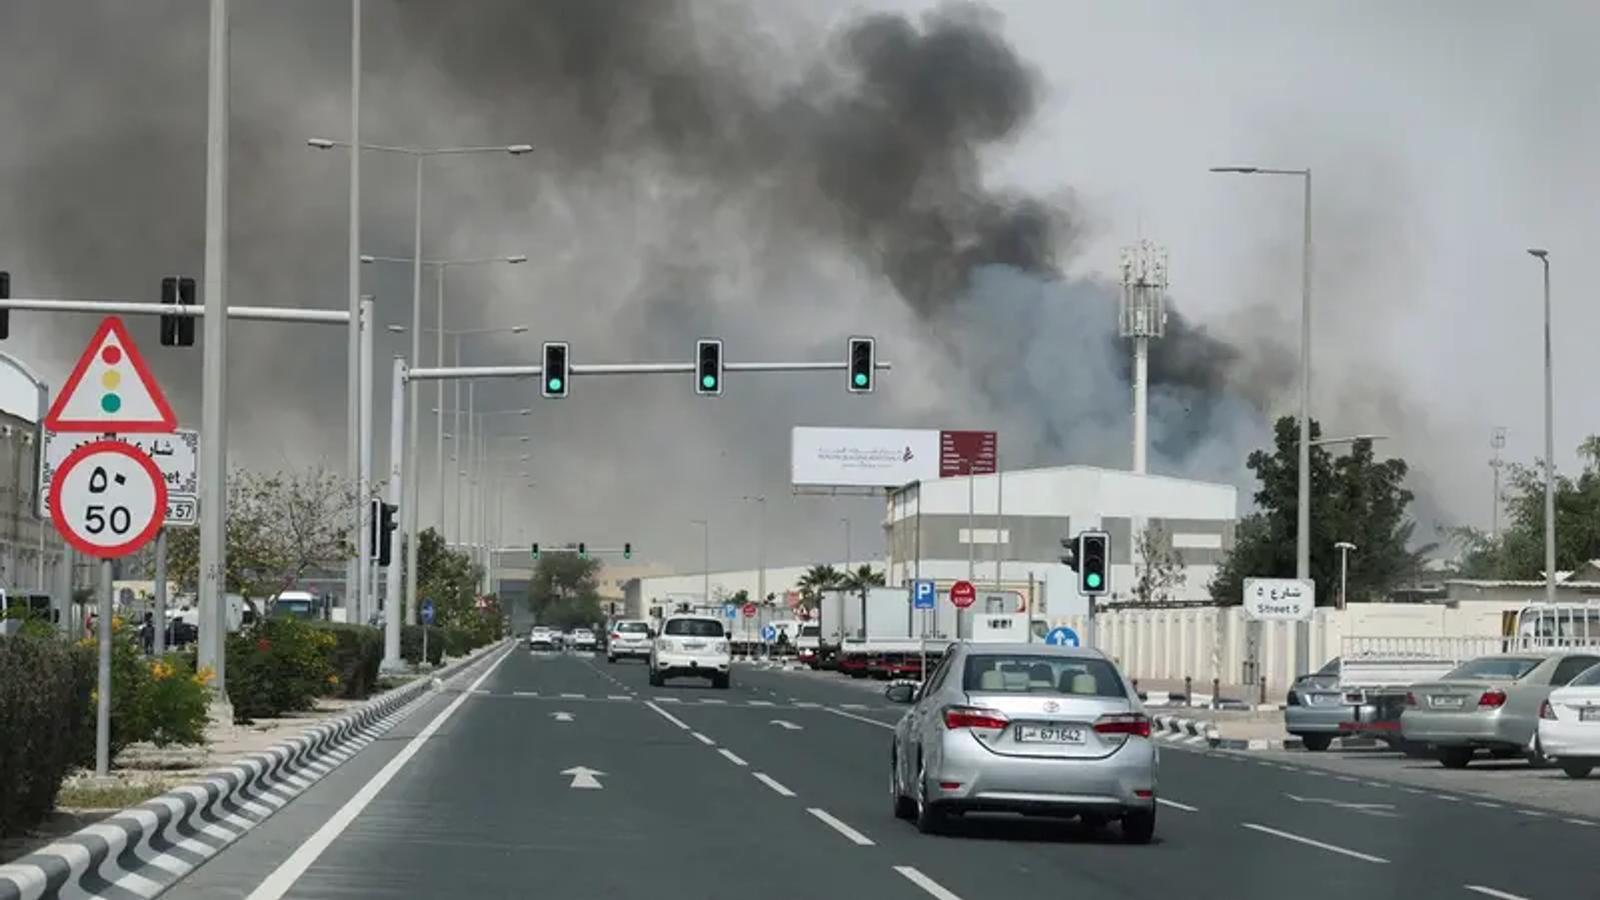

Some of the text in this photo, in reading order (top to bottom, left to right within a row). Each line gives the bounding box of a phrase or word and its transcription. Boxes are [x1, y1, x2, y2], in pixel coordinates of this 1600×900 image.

[88, 466, 127, 494] ٥٠
[175, 504, 192, 518] 57
[85, 505, 131, 534] 50
[918, 583, 931, 600] P
[1270, 587, 1301, 600] شارع
[1257, 604, 1290, 614] Street
[1040, 728, 1081, 741] 671642
